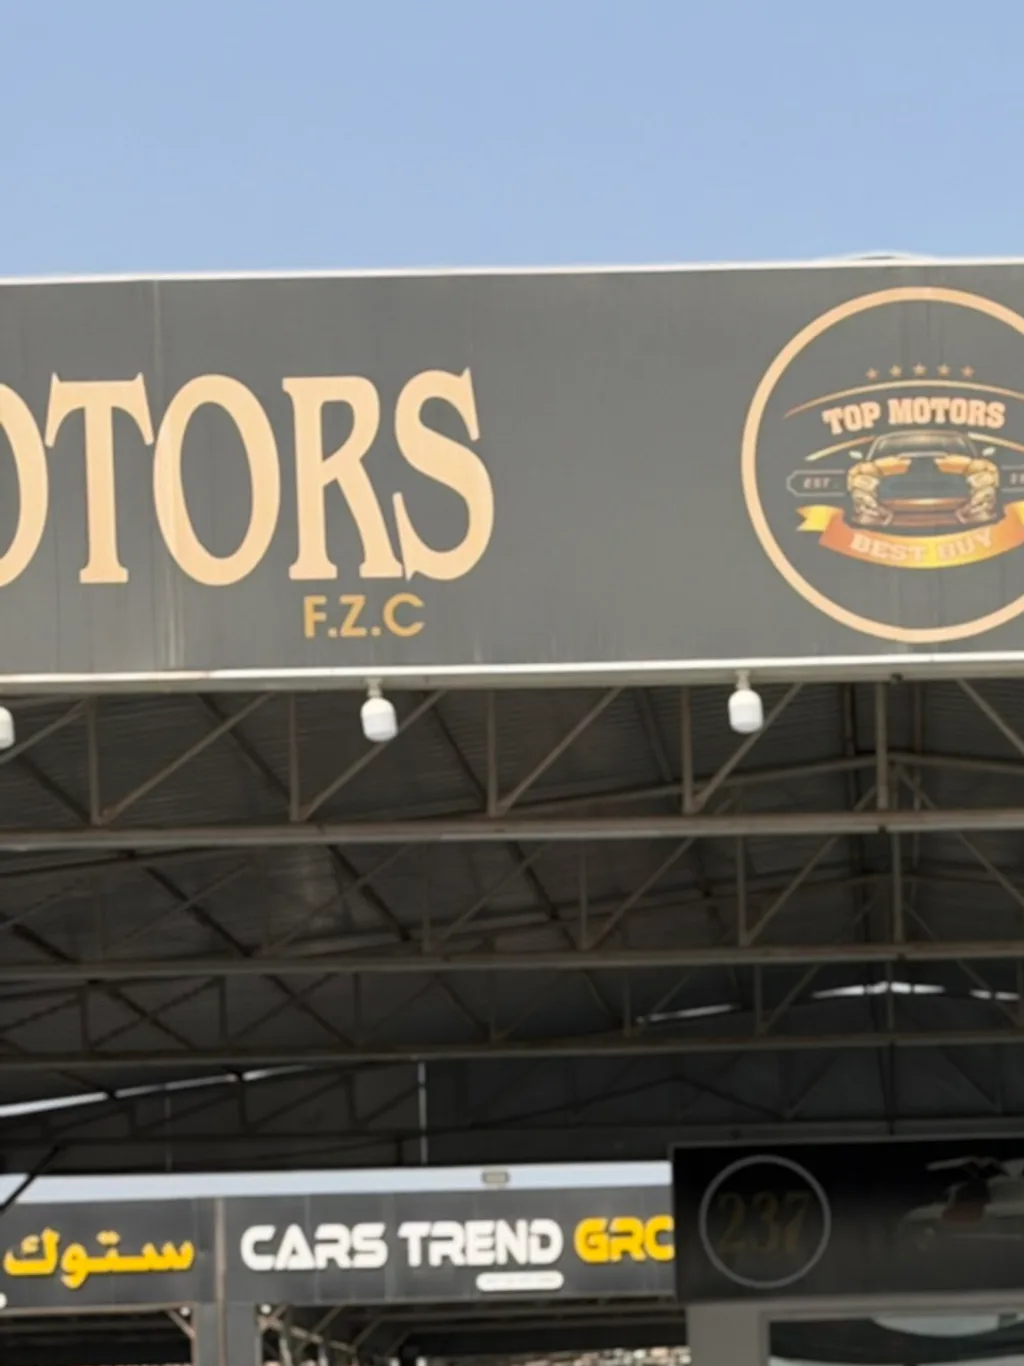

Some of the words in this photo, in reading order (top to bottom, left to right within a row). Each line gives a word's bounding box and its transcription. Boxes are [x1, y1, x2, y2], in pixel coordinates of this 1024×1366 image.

[822, 401, 881, 435] TOP
[888, 397, 1006, 429] MOTORS
[849, 532, 927, 562] BEST
[937, 529, 993, 559] BUY
[303, 592, 425, 638] F.Z.C
[240, 1224, 388, 1271] CARS
[397, 1218, 563, 1267] TREND
[716, 1190, 812, 1255] 237
[3, 1227, 195, 1289] ستوك
